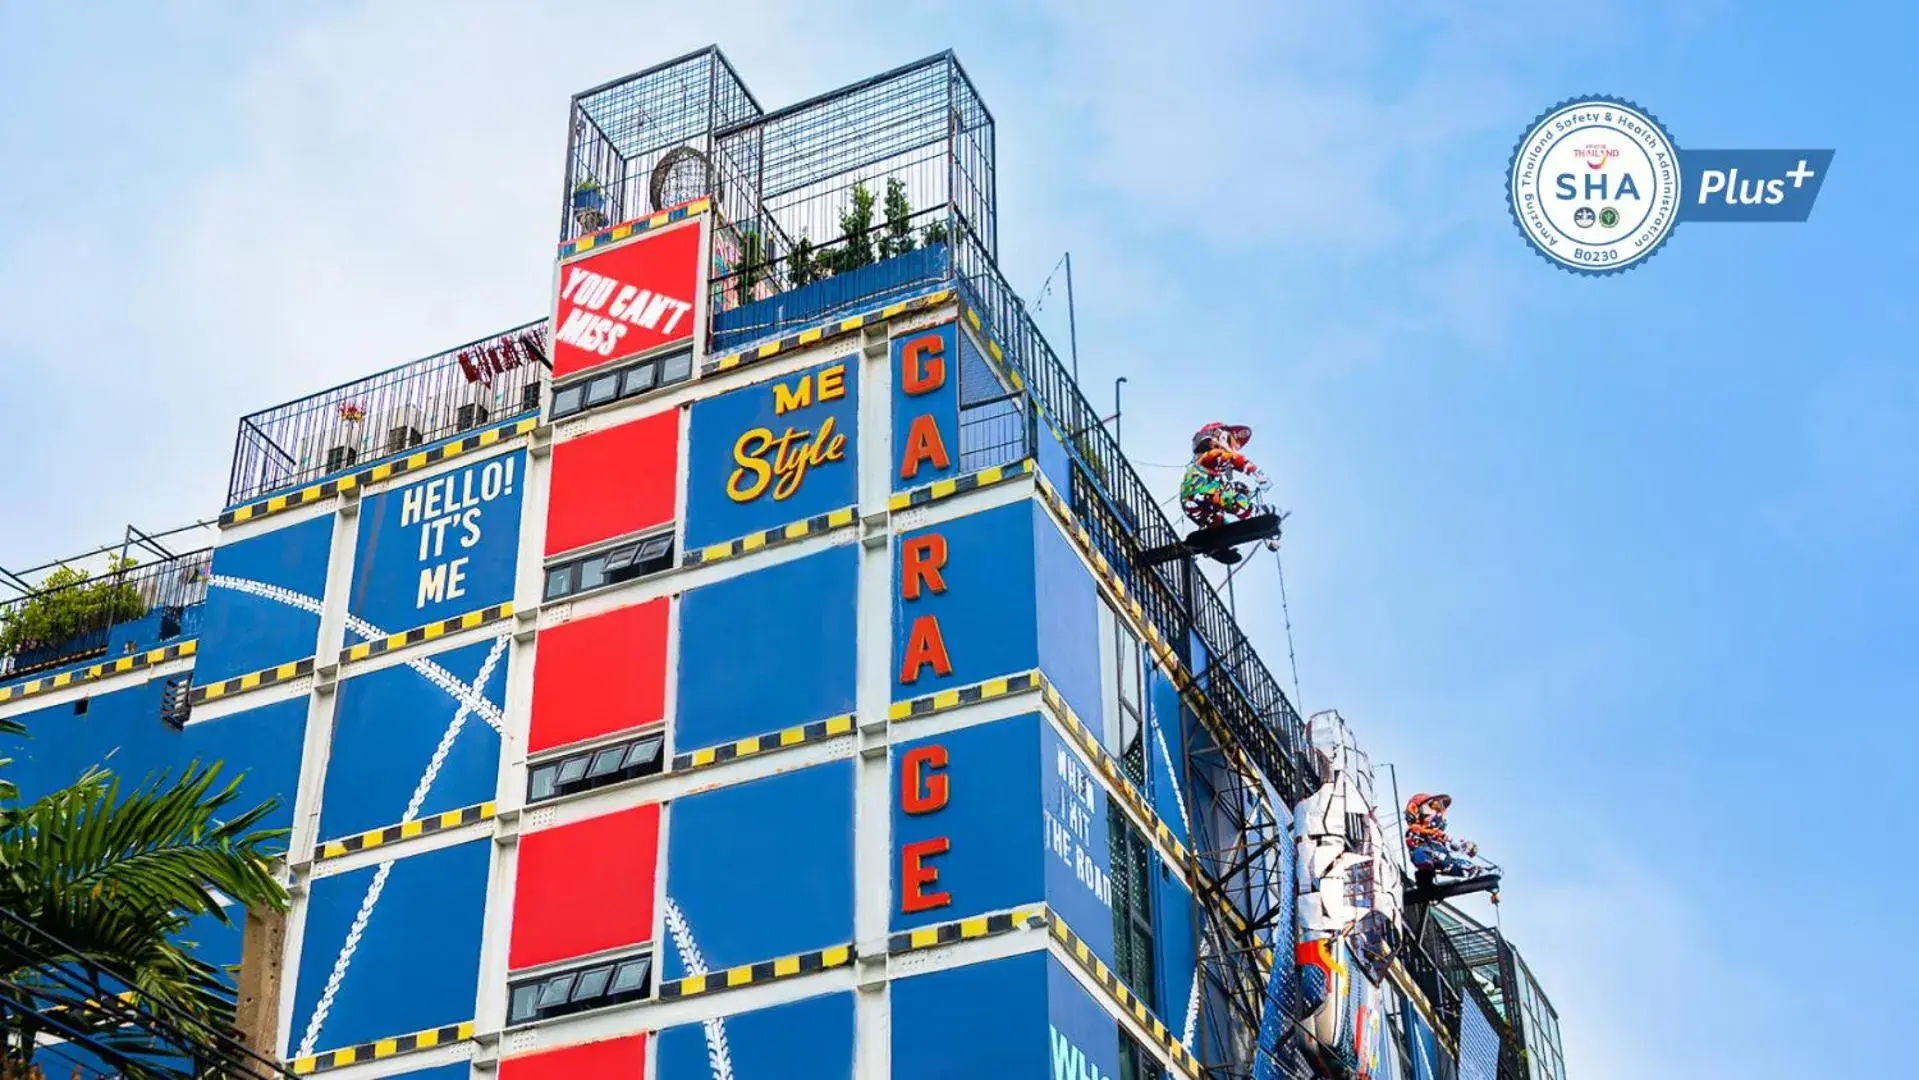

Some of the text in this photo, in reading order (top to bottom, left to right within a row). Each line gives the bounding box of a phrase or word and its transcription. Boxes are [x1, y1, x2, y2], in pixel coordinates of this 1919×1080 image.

[555, 307, 628, 356] MISS
[561, 267, 693, 335] YOU CAN'T
[772, 364, 846, 415] ME
[726, 416, 847, 502] Style
[401, 456, 515, 528] HELLO!
[416, 556, 470, 609] ME
[1056, 743, 1095, 814] WHEN
[1043, 808, 1073, 868] THE
